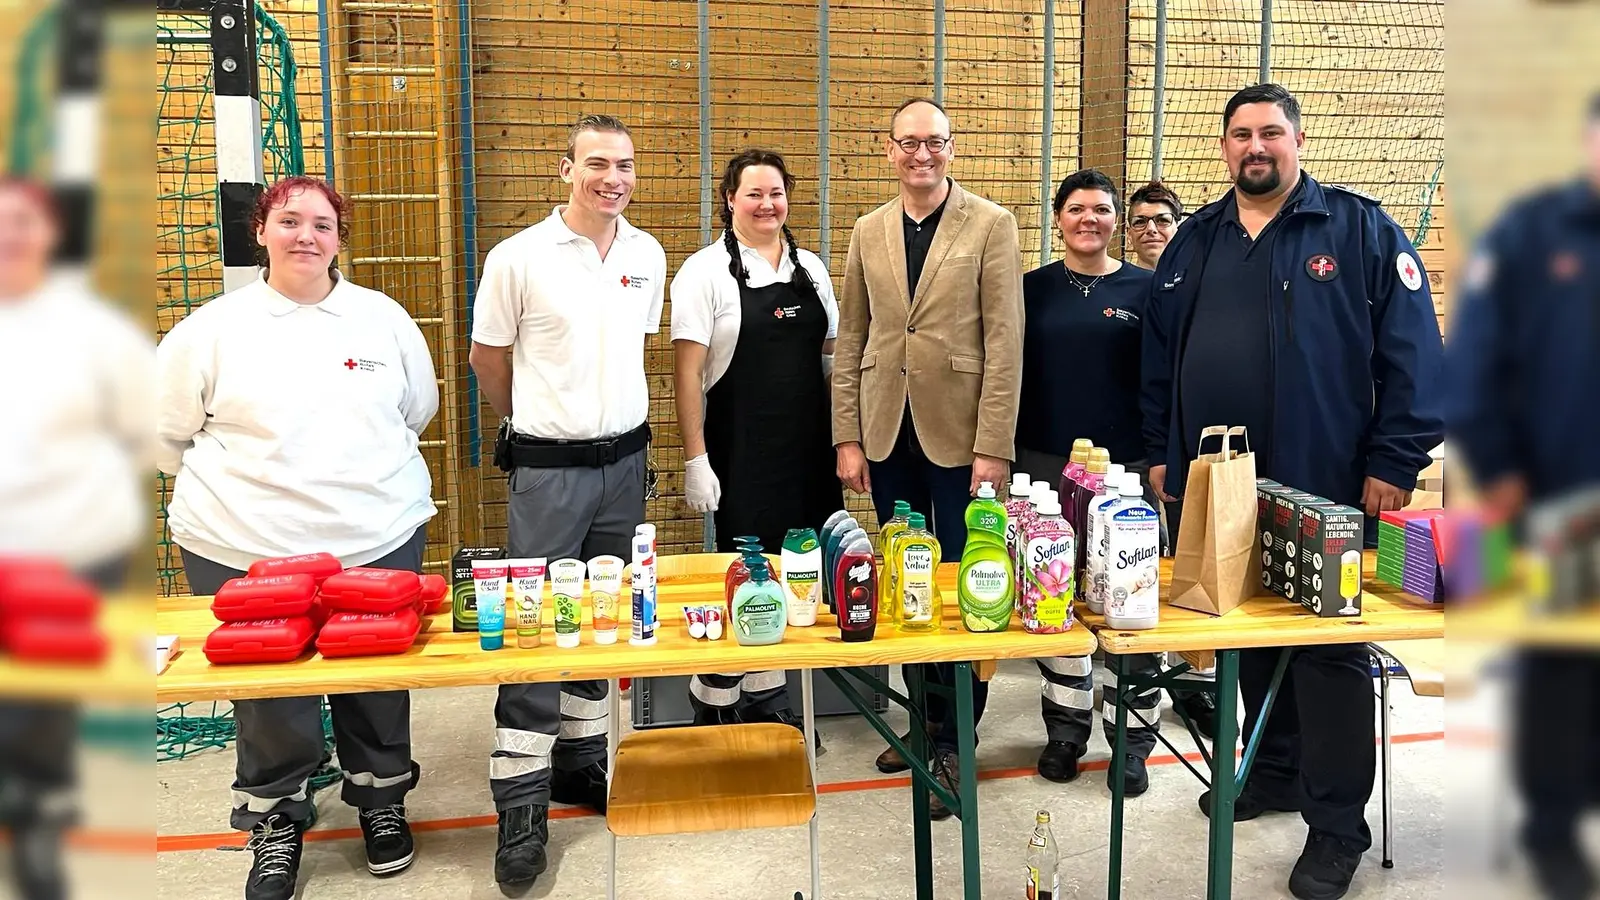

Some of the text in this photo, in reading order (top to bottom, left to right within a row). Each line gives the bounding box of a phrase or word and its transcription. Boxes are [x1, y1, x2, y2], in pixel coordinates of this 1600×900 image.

[1325, 530, 1356, 538] LEBENDIG.
[1034, 540, 1070, 562] Softlan
[1116, 546, 1157, 570] Softlan
[970, 569, 1006, 579] Palmolive
[480, 615, 502, 624] Winter
